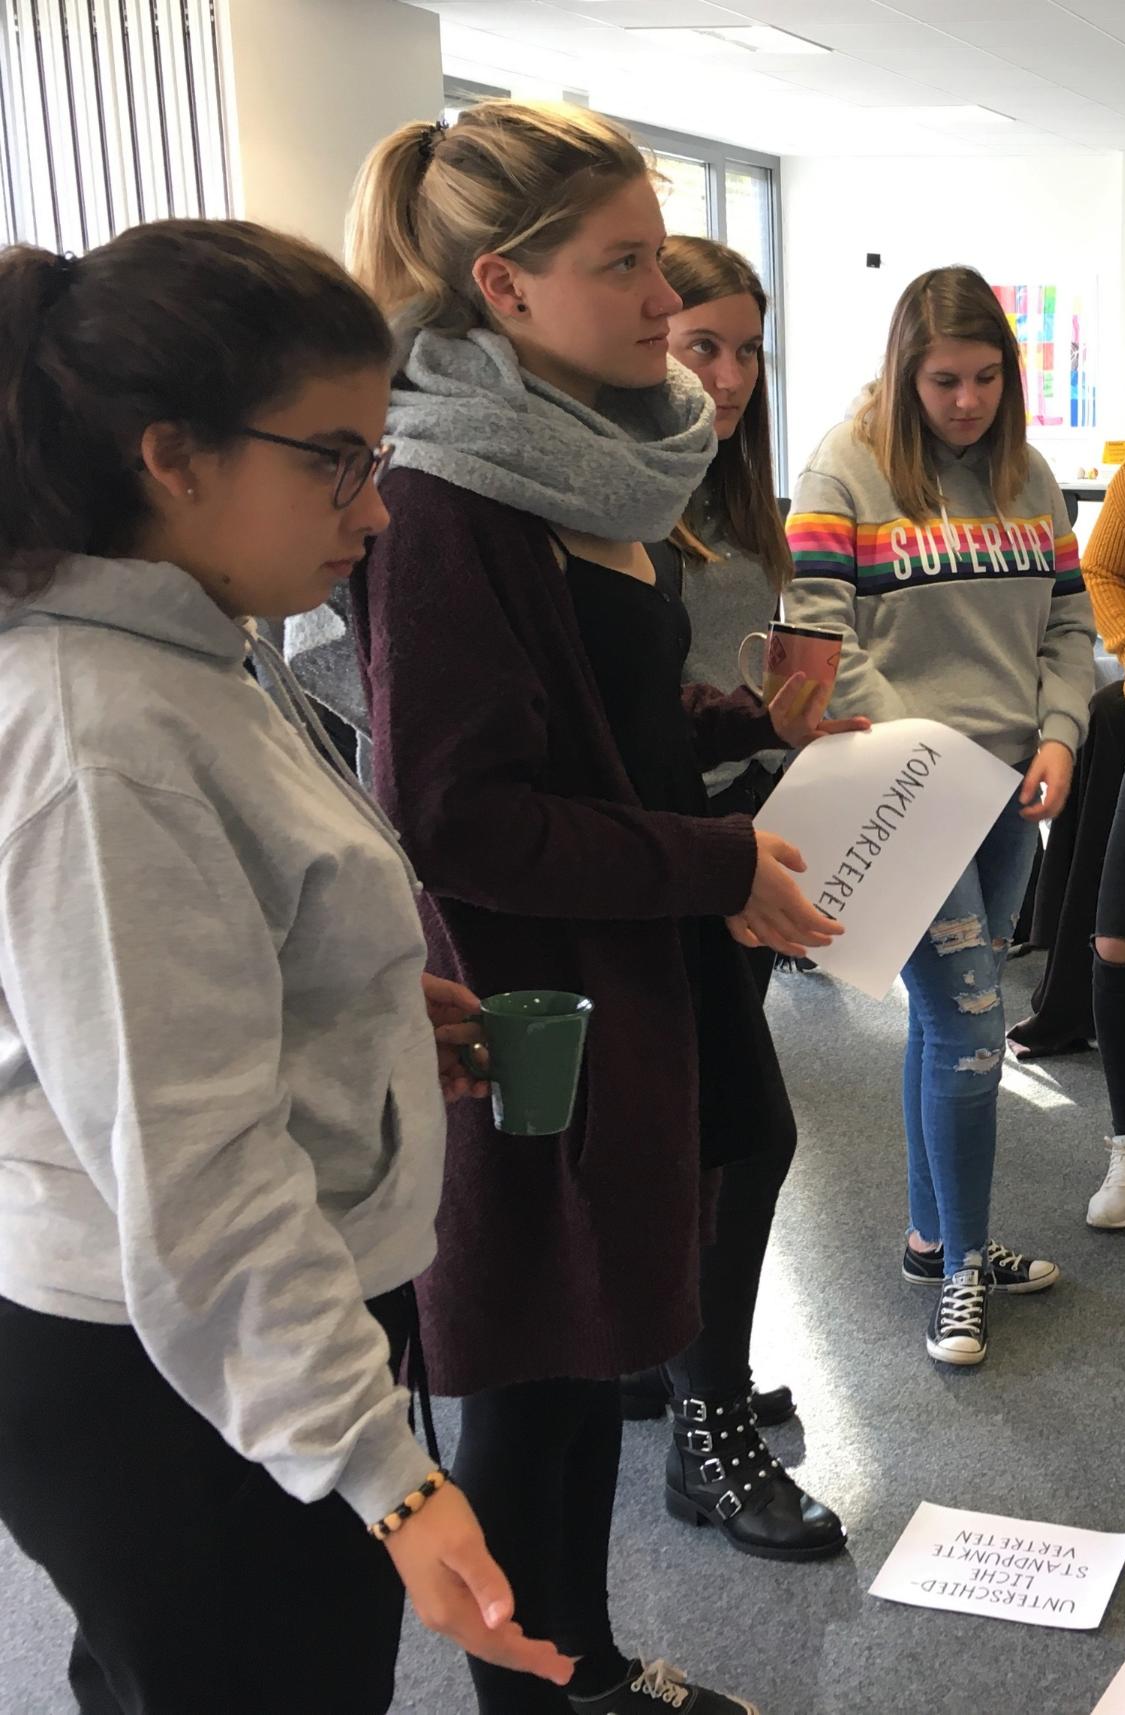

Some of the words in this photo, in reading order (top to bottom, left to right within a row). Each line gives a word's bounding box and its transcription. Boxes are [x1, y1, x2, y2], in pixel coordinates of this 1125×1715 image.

[930, 1542, 1090, 1580] STANDPUNKTE
[953, 1529, 1077, 1560] VERTRETEN
[967, 1567, 1036, 1591] LICHE
[909, 1578, 1076, 1615] UNTERSCHIED-
